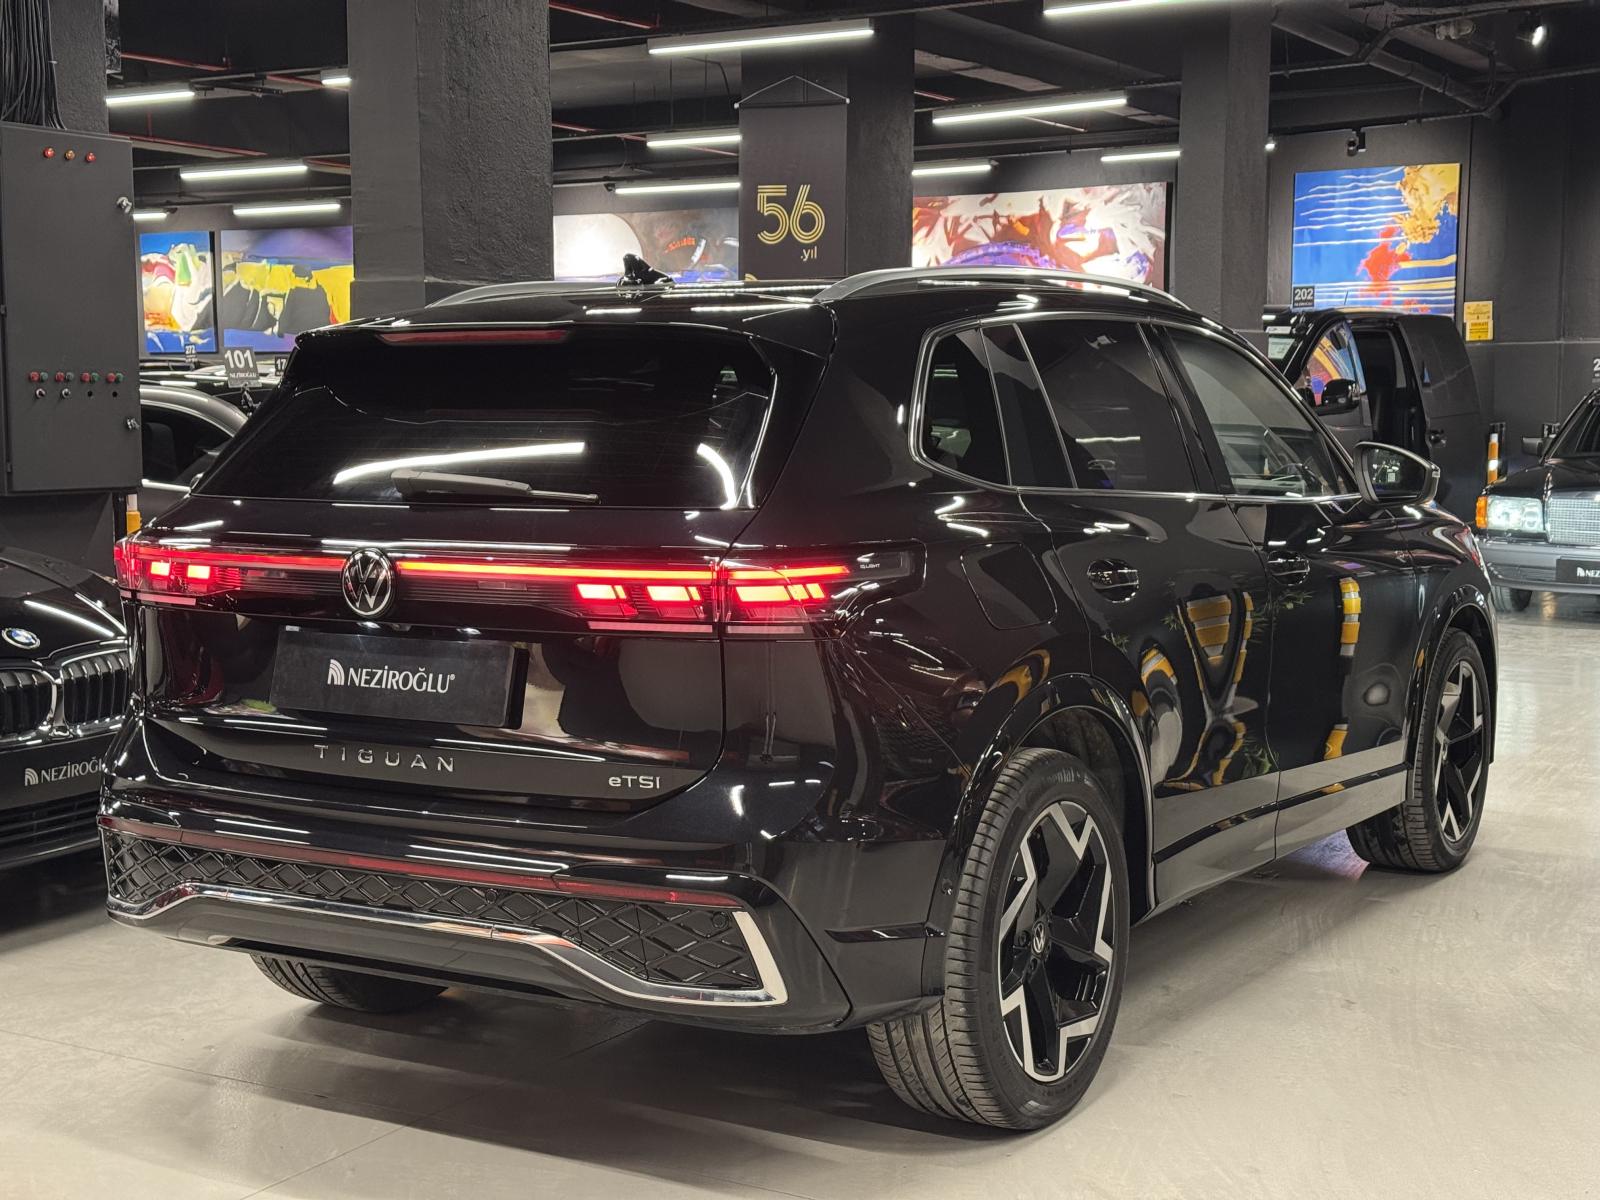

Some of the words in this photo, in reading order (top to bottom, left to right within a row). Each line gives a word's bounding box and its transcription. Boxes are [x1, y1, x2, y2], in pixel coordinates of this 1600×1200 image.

[757, 184, 825, 244] 56
[1295, 288, 1313, 300] 202
[225, 350, 254, 368] 101
[275, 358, 288, 370] 17
[314, 744, 453, 772] TIGUAN
[608, 775, 660, 789] eTSI
